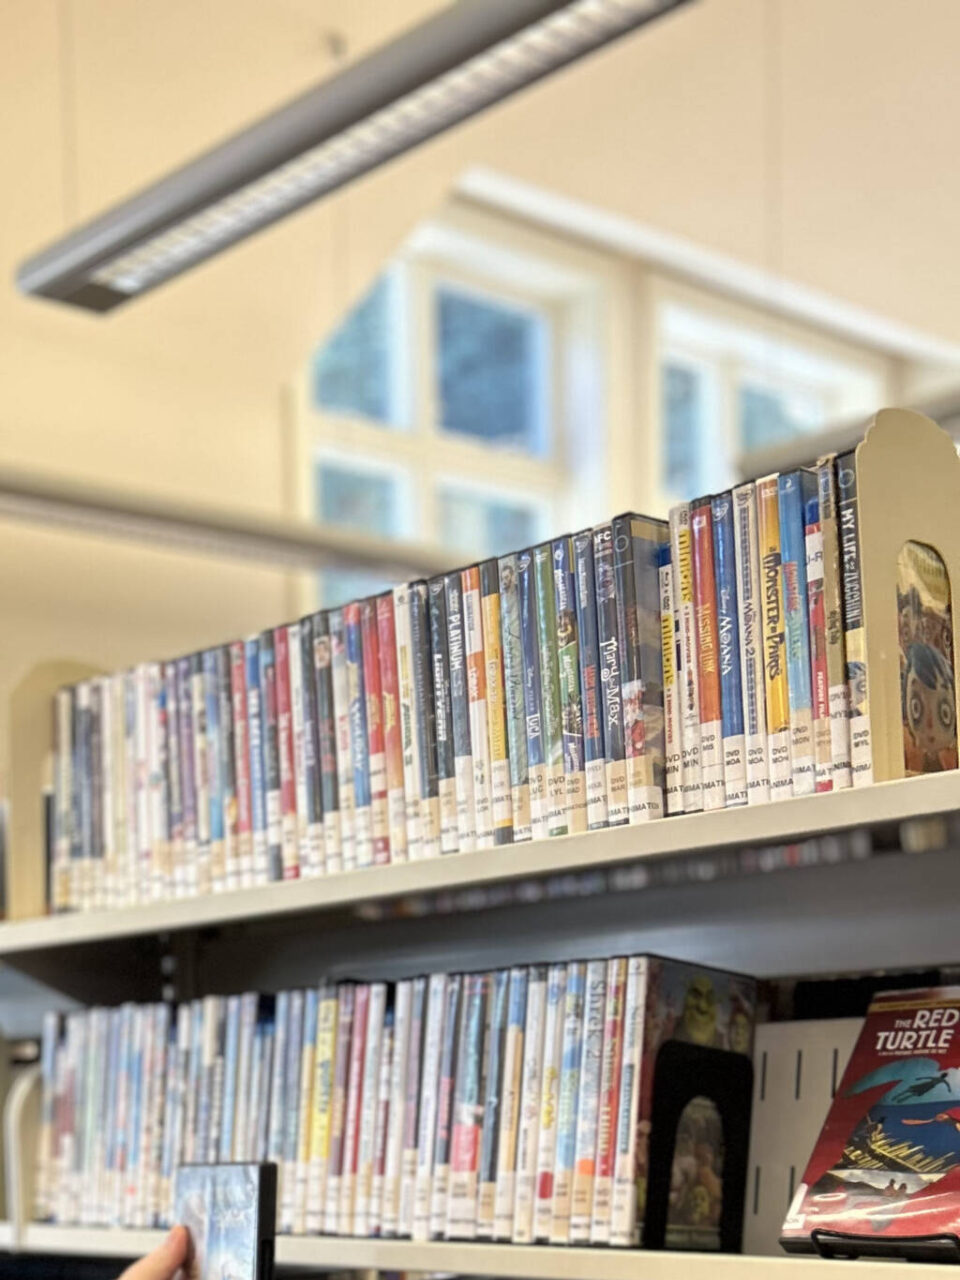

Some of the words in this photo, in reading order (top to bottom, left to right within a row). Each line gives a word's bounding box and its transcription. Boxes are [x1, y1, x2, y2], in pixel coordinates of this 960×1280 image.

[841, 508, 856, 531] MY
[594, 531, 611, 544] IFC
[842, 533, 857, 562] LIFE
[678, 529, 692, 603] minions
[763, 552, 782, 626] MONSTER
[844, 571, 863, 624] ZUCCHINI
[696, 603, 714, 651] MISSING
[743, 602, 754, 646] MOANA
[448, 614, 462, 671] PLATINUM
[661, 614, 674, 686] minions
[719, 615, 733, 676] MOANA
[745, 648, 755, 657] 2
[600, 637, 620, 678] Mary
[702, 652, 715, 674] LINK
[766, 632, 786, 681] PARIS
[815, 671, 825, 701] FEATURE
[527, 714, 541, 739] LUCA
[853, 730, 869, 739] DVD
[701, 735, 716, 743] DVD
[772, 746, 788, 755] DVD
[682, 747, 699, 758] DVD
[725, 750, 740, 758] DVD
[748, 748, 763, 756] DVD
[683, 759, 699, 769] MIN
[548, 776, 565, 786] DVD
[587, 980, 606, 1040] Shrek
[894, 1019, 912, 1029] THE
[912, 1008, 960, 1029] RED
[875, 1029, 955, 1050] TURTLE
[586, 1049, 602, 1060] 2
